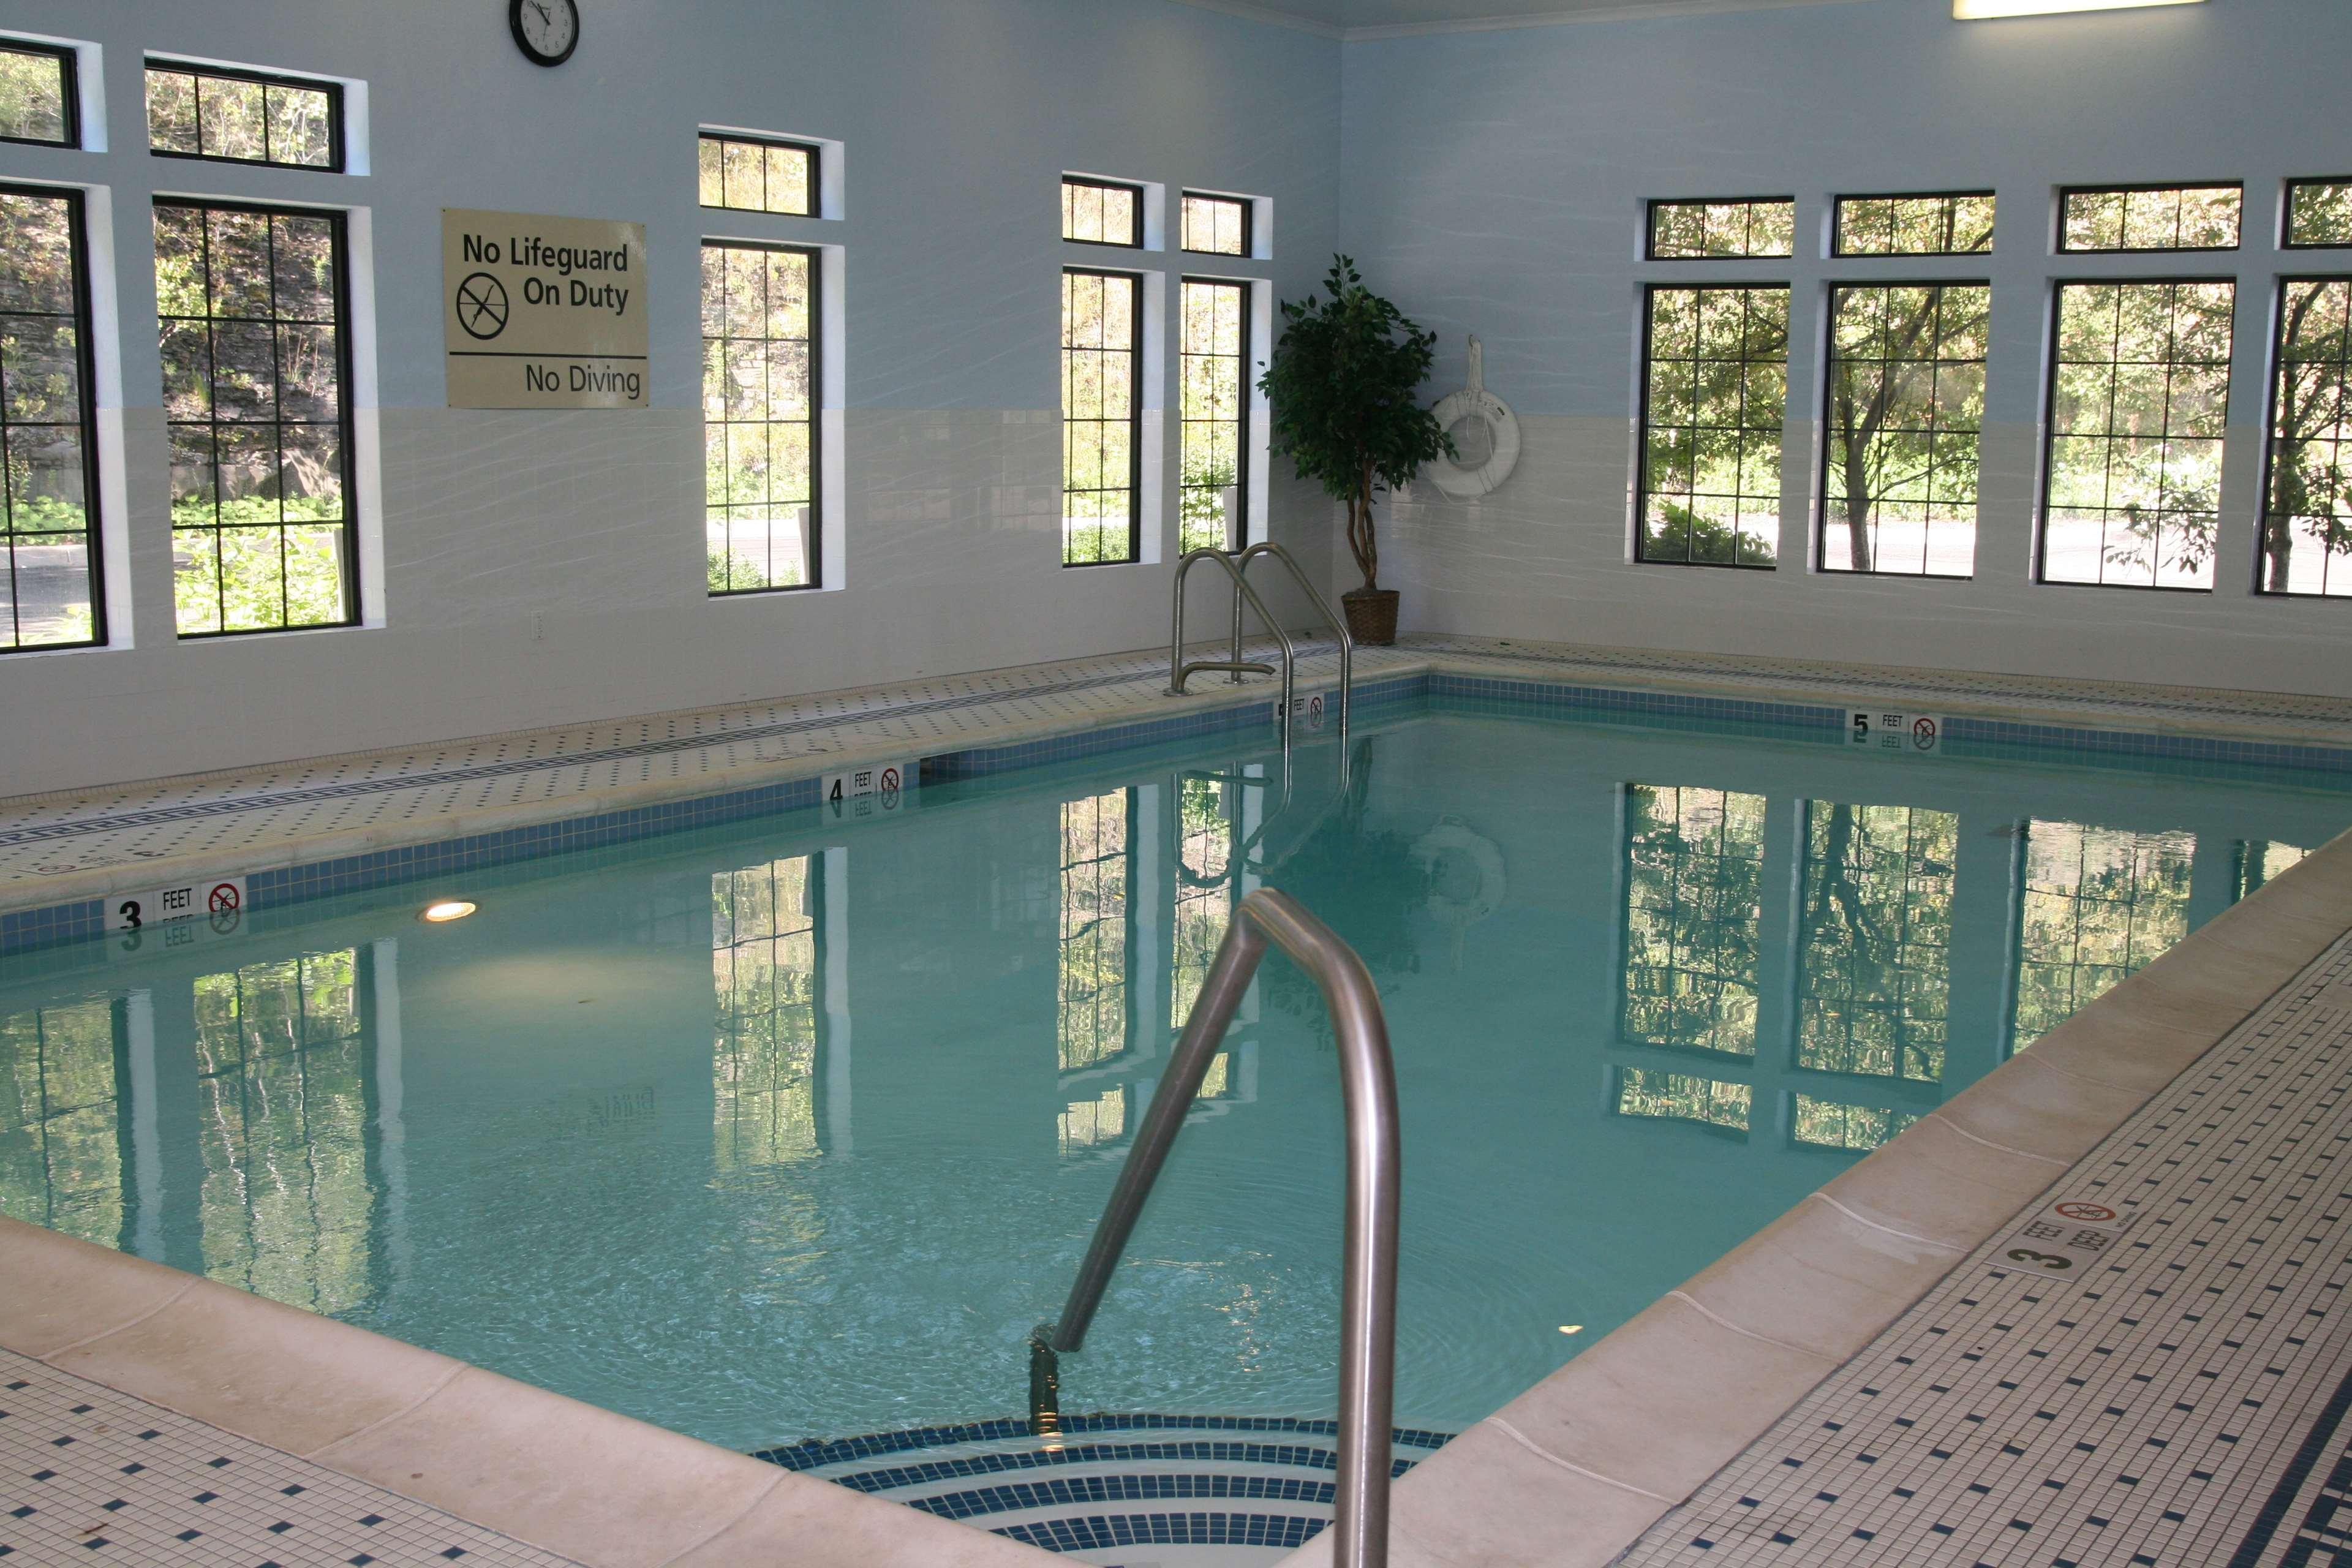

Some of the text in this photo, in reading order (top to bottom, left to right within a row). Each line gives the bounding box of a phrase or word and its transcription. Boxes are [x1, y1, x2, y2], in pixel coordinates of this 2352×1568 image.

[464, 234, 627, 276] No Lifeguard
[524, 277, 629, 316] On Duty
[526, 364, 640, 400] No Diving
[1853, 714, 1903, 732] 5 FEET
[830, 771, 872, 801] 4 FEET
[119, 901, 141, 929] 3
[163, 888, 192, 911] FEET
[2007, 1221, 2073, 1269] 3 FEET
[2067, 1230, 2111, 1251] DEEP
